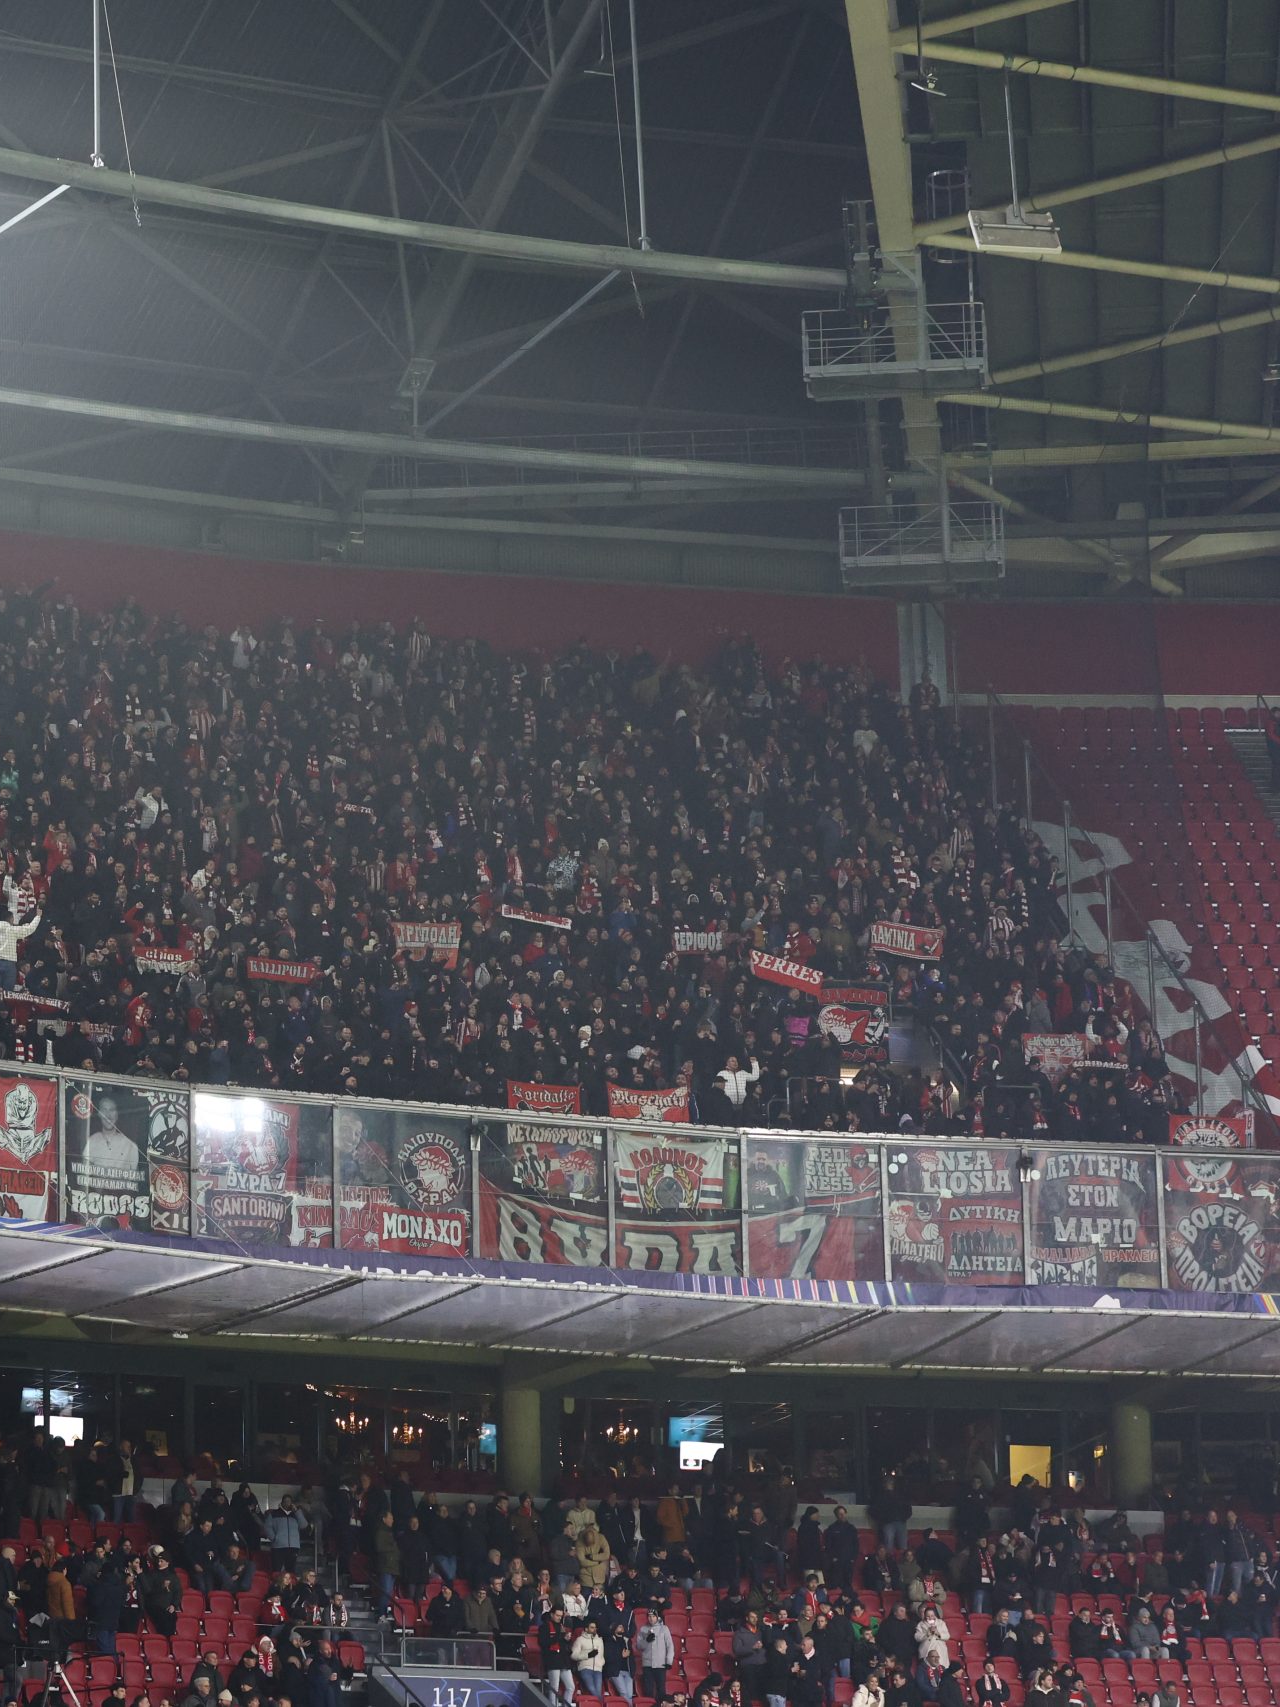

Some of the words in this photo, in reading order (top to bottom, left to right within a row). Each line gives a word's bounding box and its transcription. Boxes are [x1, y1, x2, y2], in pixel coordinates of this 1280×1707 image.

[871, 924, 915, 951] KAMINIA
[249, 960, 307, 979] KALLIPOLI
[751, 949, 823, 985] SERRES
[630, 1146, 708, 1176] ΚΟΛΩΝΟΣ
[807, 1146, 849, 1163] RED
[936, 1150, 993, 1171] NEA
[806, 1161, 850, 1178] SICK
[274, 1173, 286, 1192] 7
[448, 1182, 459, 1196] 7
[806, 1175, 854, 1194] NESS
[922, 1169, 1014, 1194] LIOSIA
[1067, 1184, 1119, 1208] ΣΤΟΝ
[213, 1196, 285, 1220] SANTORINI
[949, 1205, 1021, 1223] ΔΥΤΙΚΗ
[1053, 1216, 1137, 1247] ΜΑΡΙΟ
[1177, 1203, 1260, 1245] ΒΟΡΕΙΑ
[779, 1214, 827, 1280] 7
[891, 1238, 945, 1262] AMATERO
[948, 1255, 1023, 1272] ΑΛΗΤΕΙΑ
[433, 1687, 471, 1707] 117
